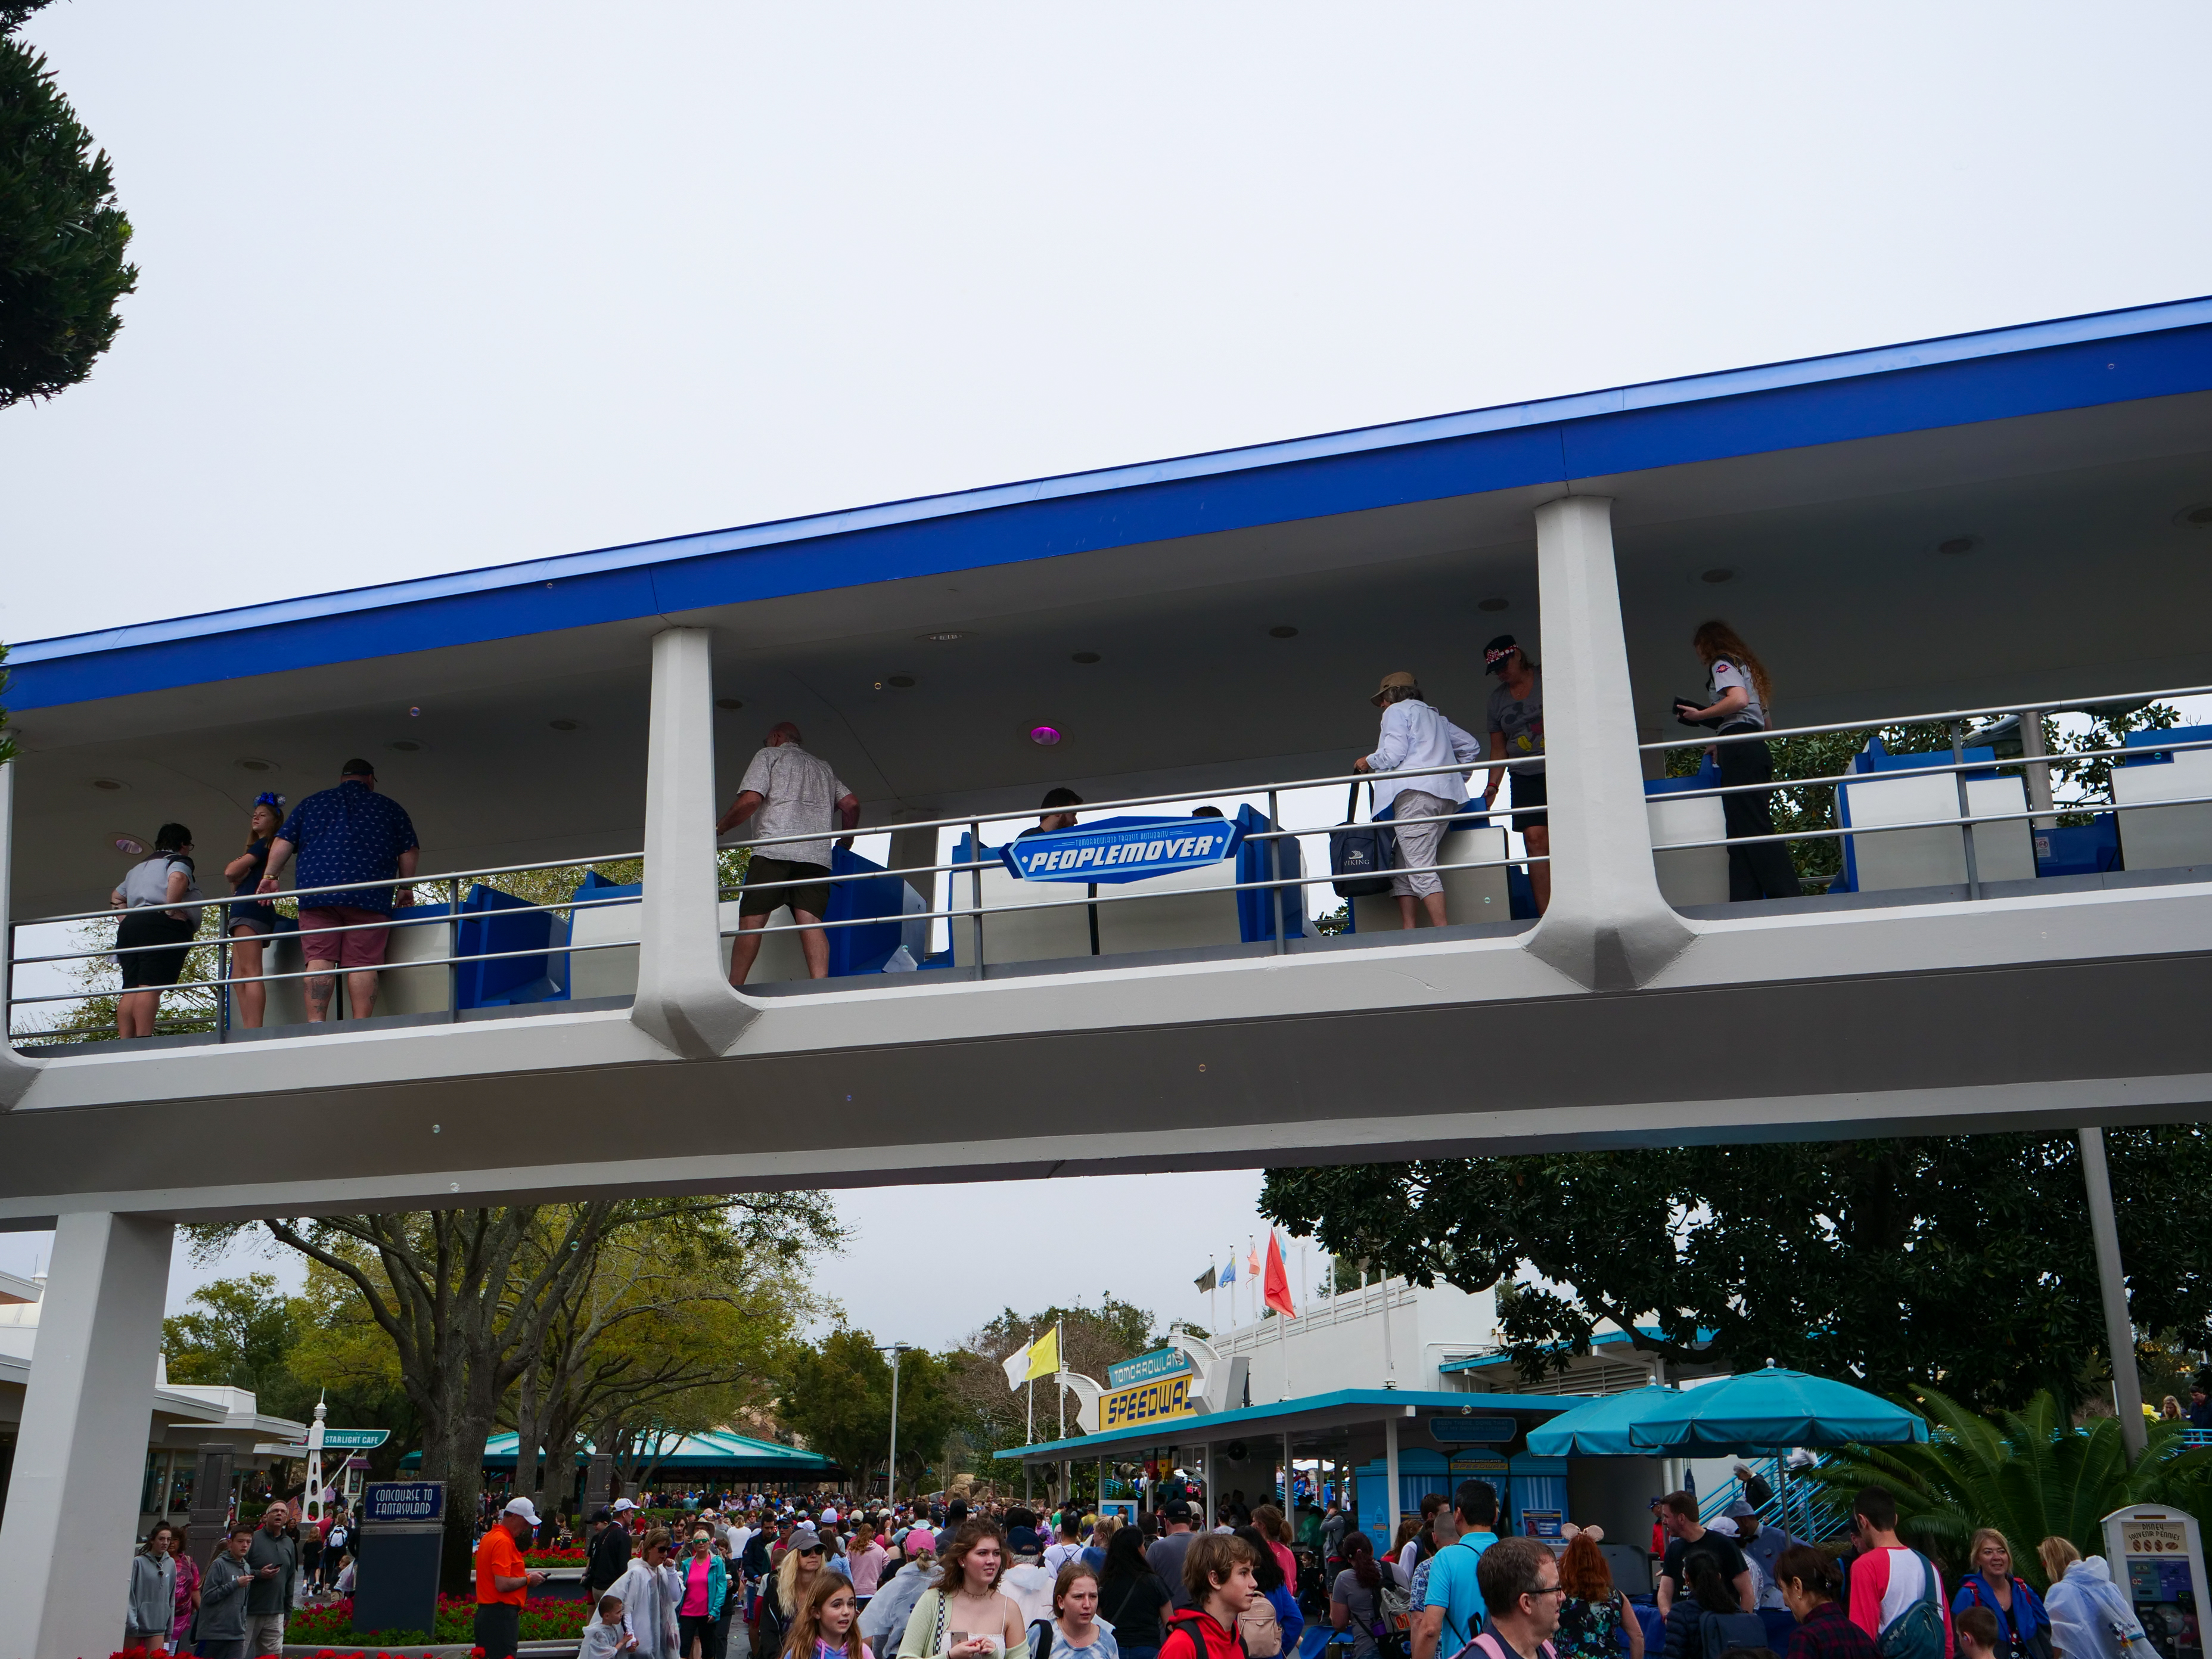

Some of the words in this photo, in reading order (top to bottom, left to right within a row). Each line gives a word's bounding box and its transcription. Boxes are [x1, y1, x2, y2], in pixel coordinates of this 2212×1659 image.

[1076, 837, 1117, 847] TOMORROWLAND
[1119, 834, 1139, 842] TRANSIT
[1141, 831, 1169, 840] AUTHORITY
[1028, 835, 1214, 873] PEOPLEMOVER
[375, 1489, 420, 1502] CONCOURSE
[424, 1489, 433, 1501] TO
[375, 1502, 430, 1515] FANTASYLAND
[2129, 1530, 2154, 1540] SOUVENIR
[2155, 1531, 2180, 1541] PENNIES
[1396, 1613, 1411, 1629] 07
